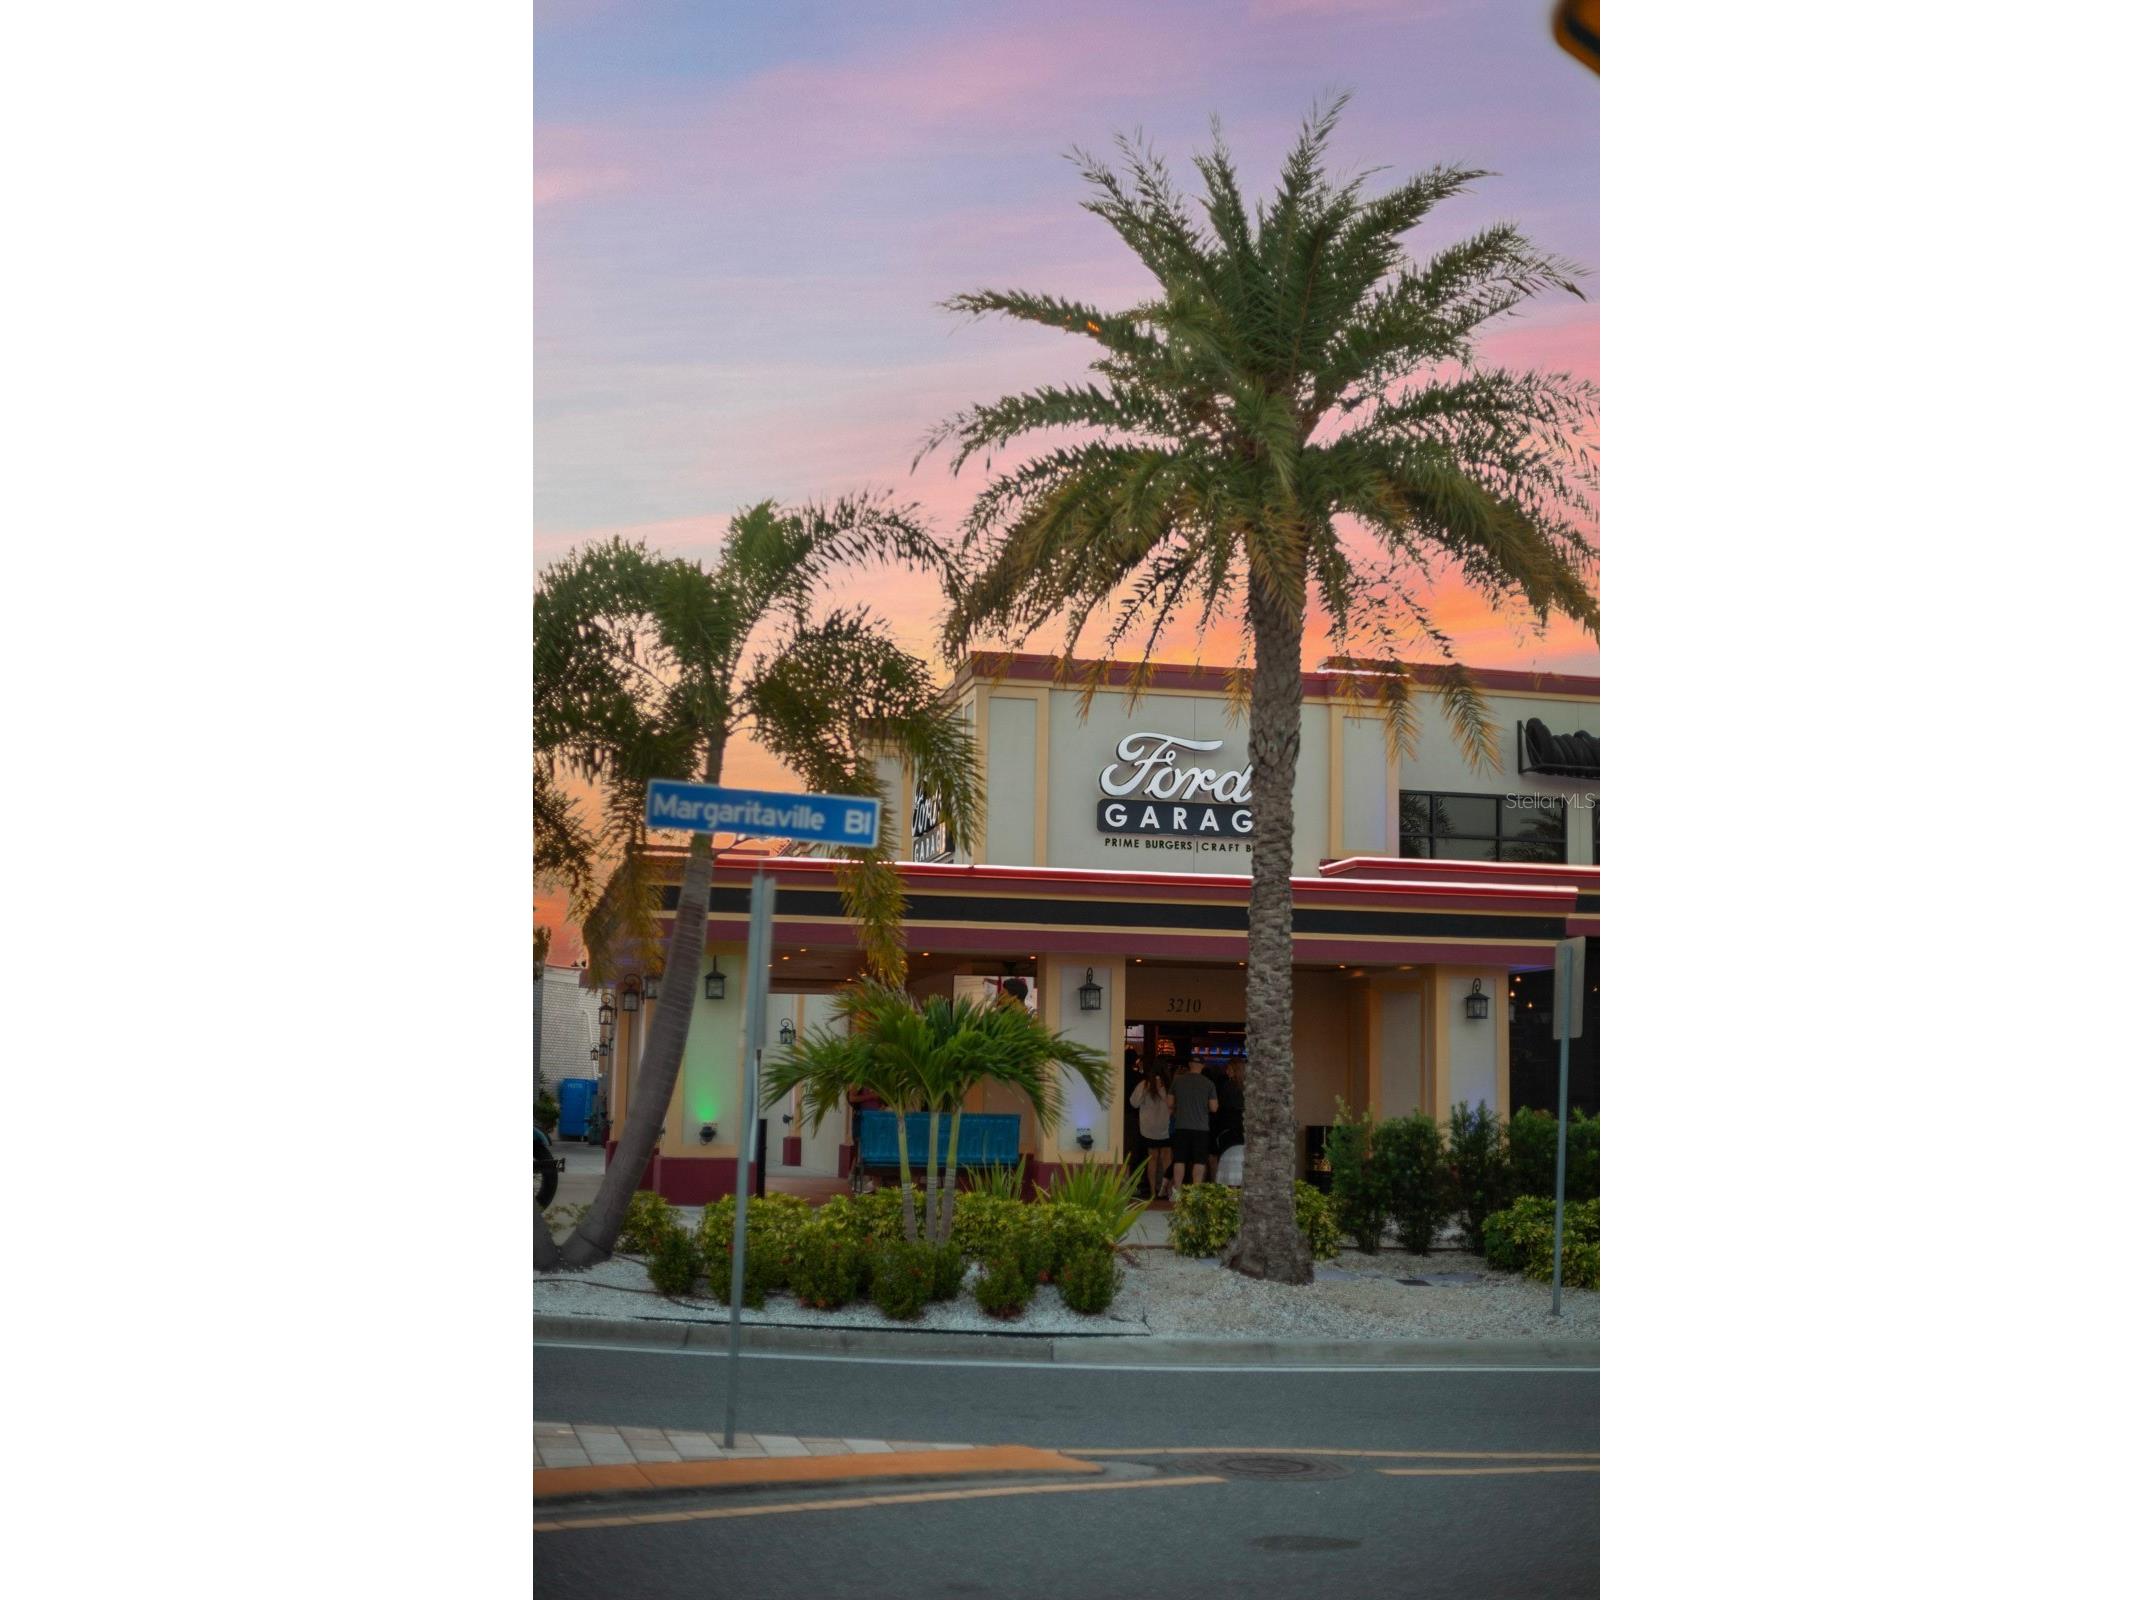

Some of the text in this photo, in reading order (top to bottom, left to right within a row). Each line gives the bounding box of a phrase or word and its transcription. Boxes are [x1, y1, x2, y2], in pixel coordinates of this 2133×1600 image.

[653, 793, 825, 830] Margaritaville
[1104, 803, 1254, 833] GARAG
[1104, 837, 1140, 848] PRIME
[1145, 840, 1192, 850] BURGERS
[1201, 842, 1239, 852] CRAFT
[1168, 998, 1202, 1012] 3210
